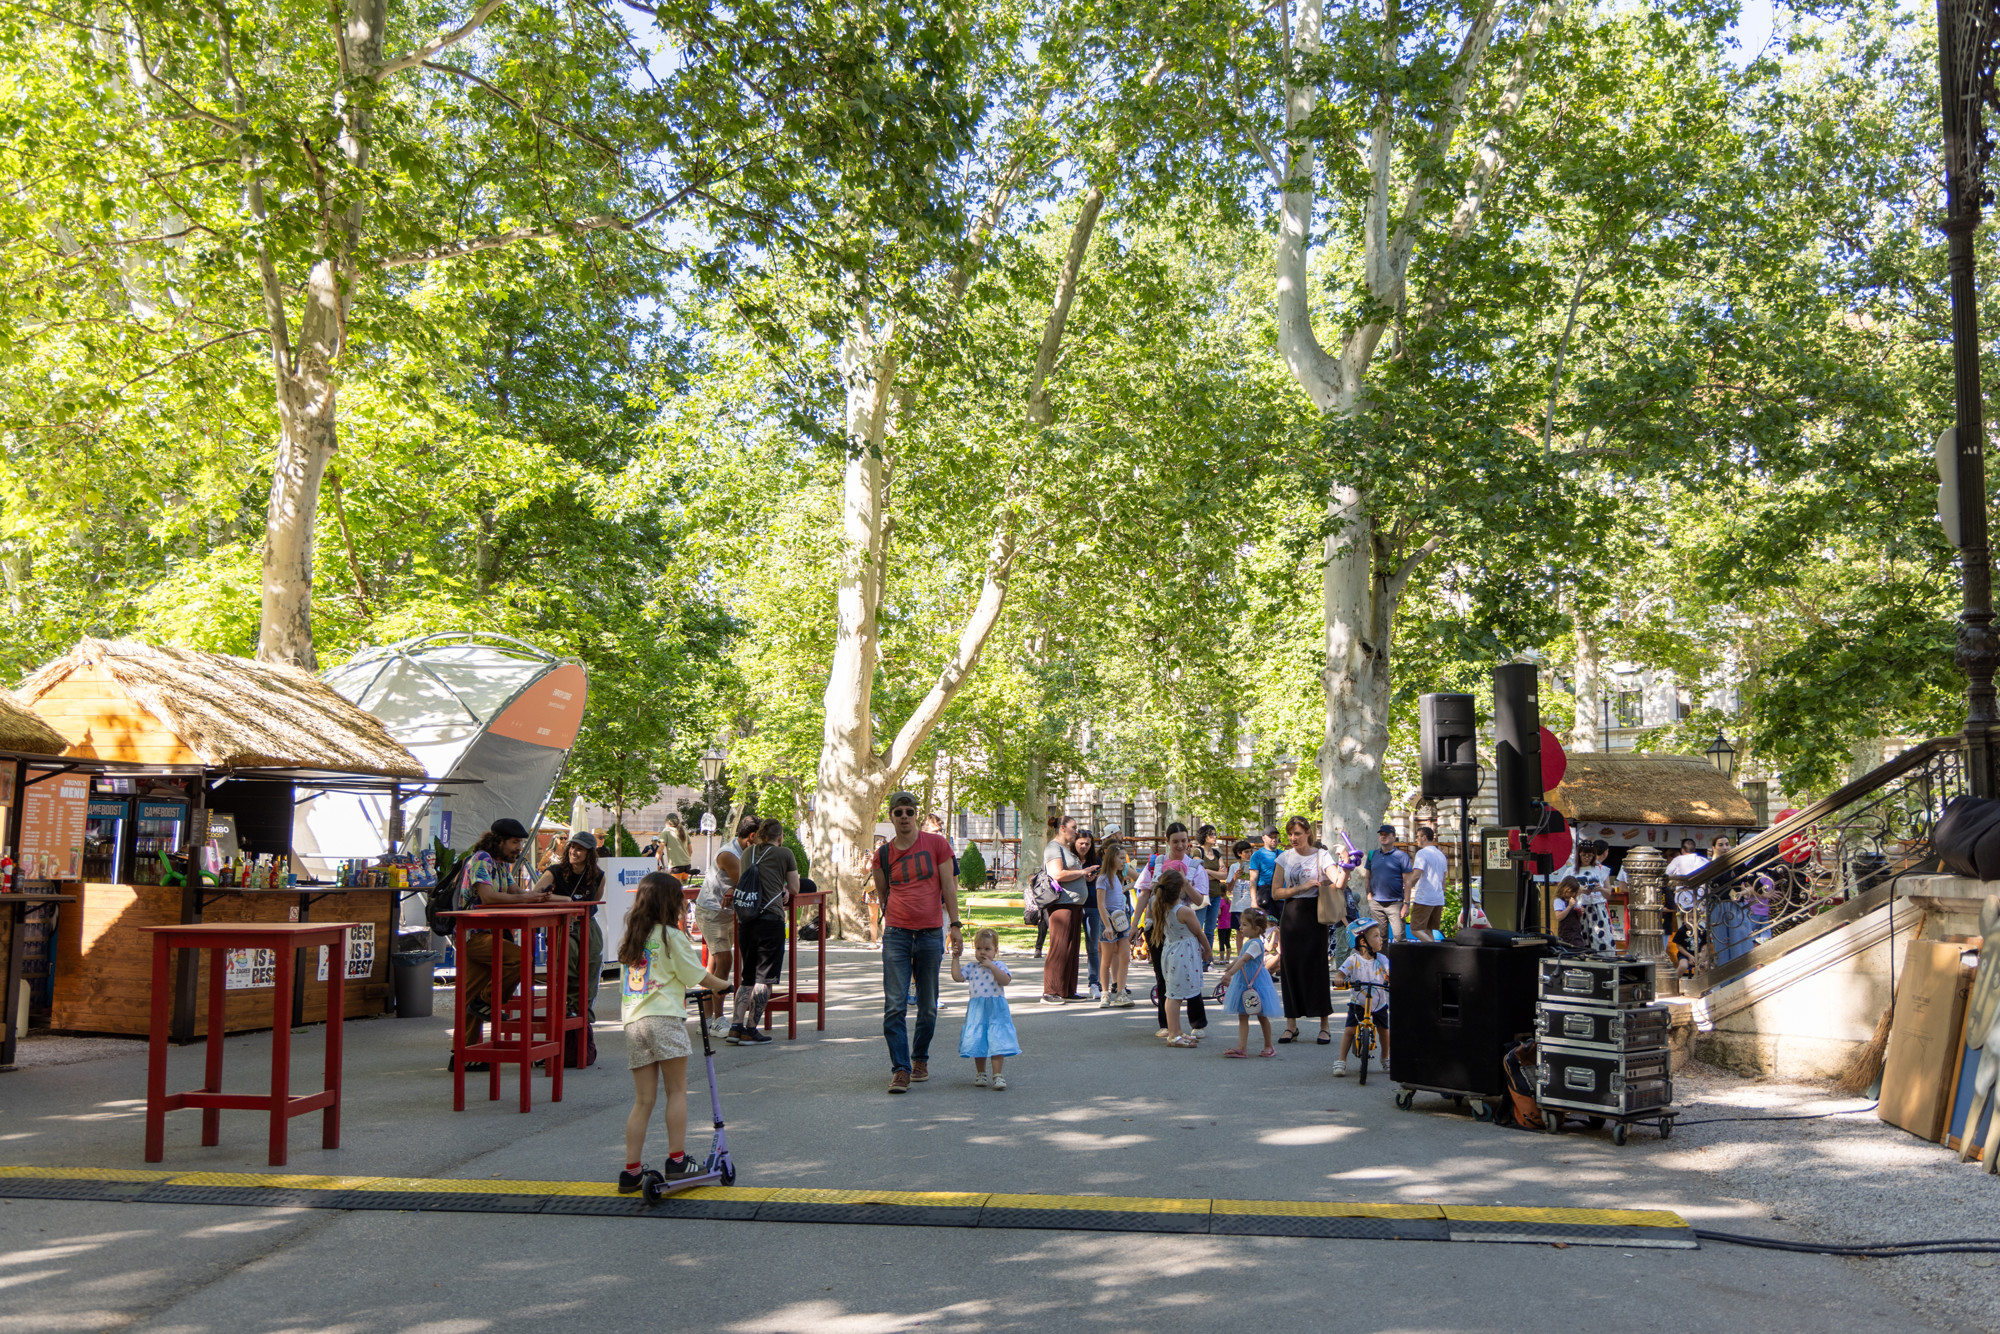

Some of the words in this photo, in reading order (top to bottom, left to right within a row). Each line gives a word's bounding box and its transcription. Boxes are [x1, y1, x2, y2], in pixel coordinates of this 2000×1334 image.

[60, 786, 86, 799] MENU
[87, 804, 123, 816] AMEBOOST
[144, 806, 181, 818] GAMEBOOST
[889, 851, 934, 885] LTD
